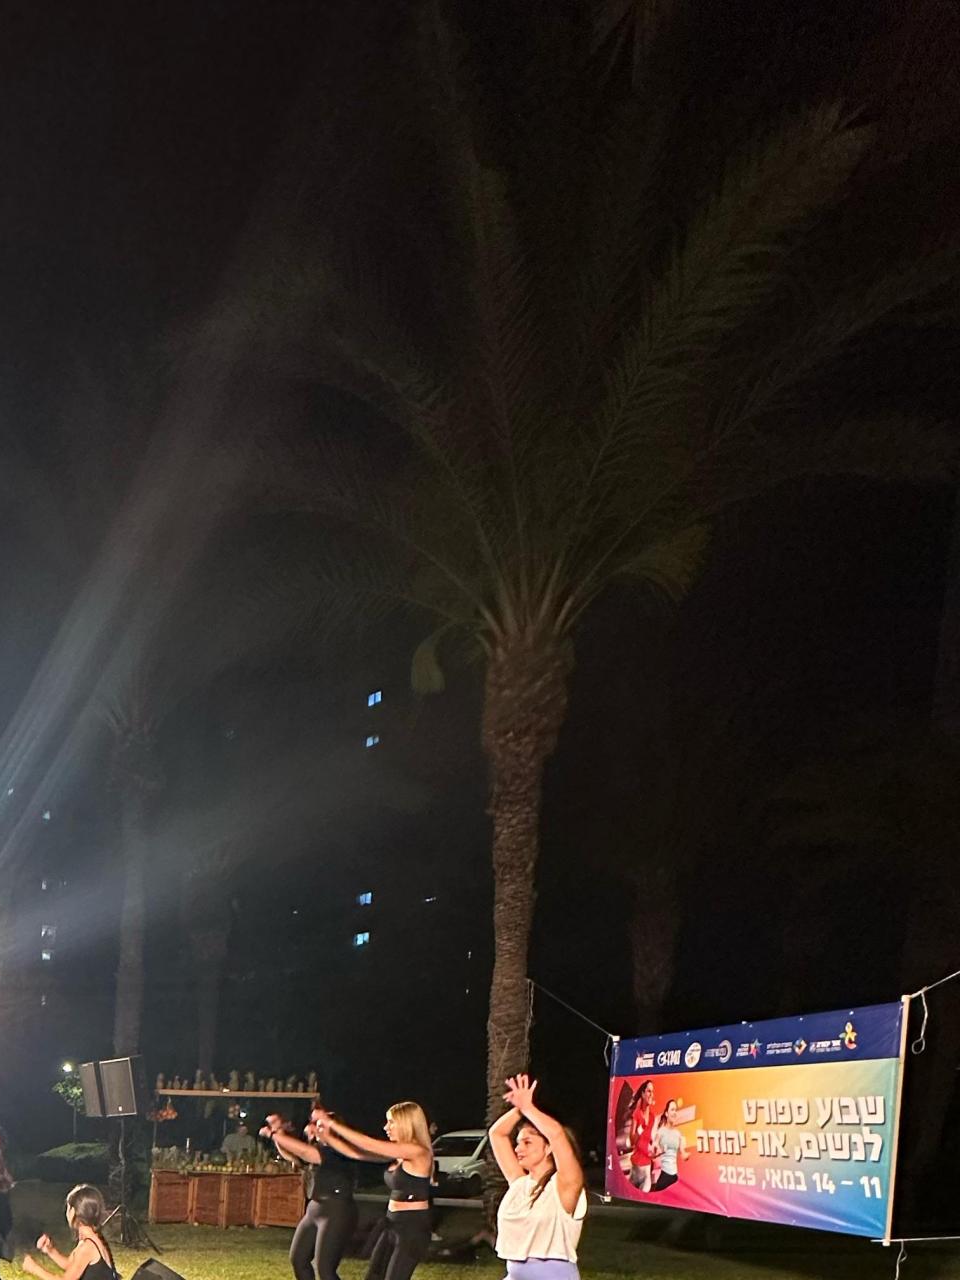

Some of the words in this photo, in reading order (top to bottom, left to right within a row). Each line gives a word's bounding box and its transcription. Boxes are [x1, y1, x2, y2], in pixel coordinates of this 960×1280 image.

[742, 1098, 810, 1125] ספורט
[814, 1095, 886, 1129] שבוע
[696, 1129, 747, 1155] יהודה
[751, 1131, 790, 1158] אור
[794, 1126, 883, 1163] לנשים,
[718, 1165, 756, 1187] 2025
[761, 1168, 808, 1191] במאי,
[812, 1172, 836, 1195] 14
[859, 1176, 882, 1199] 11
